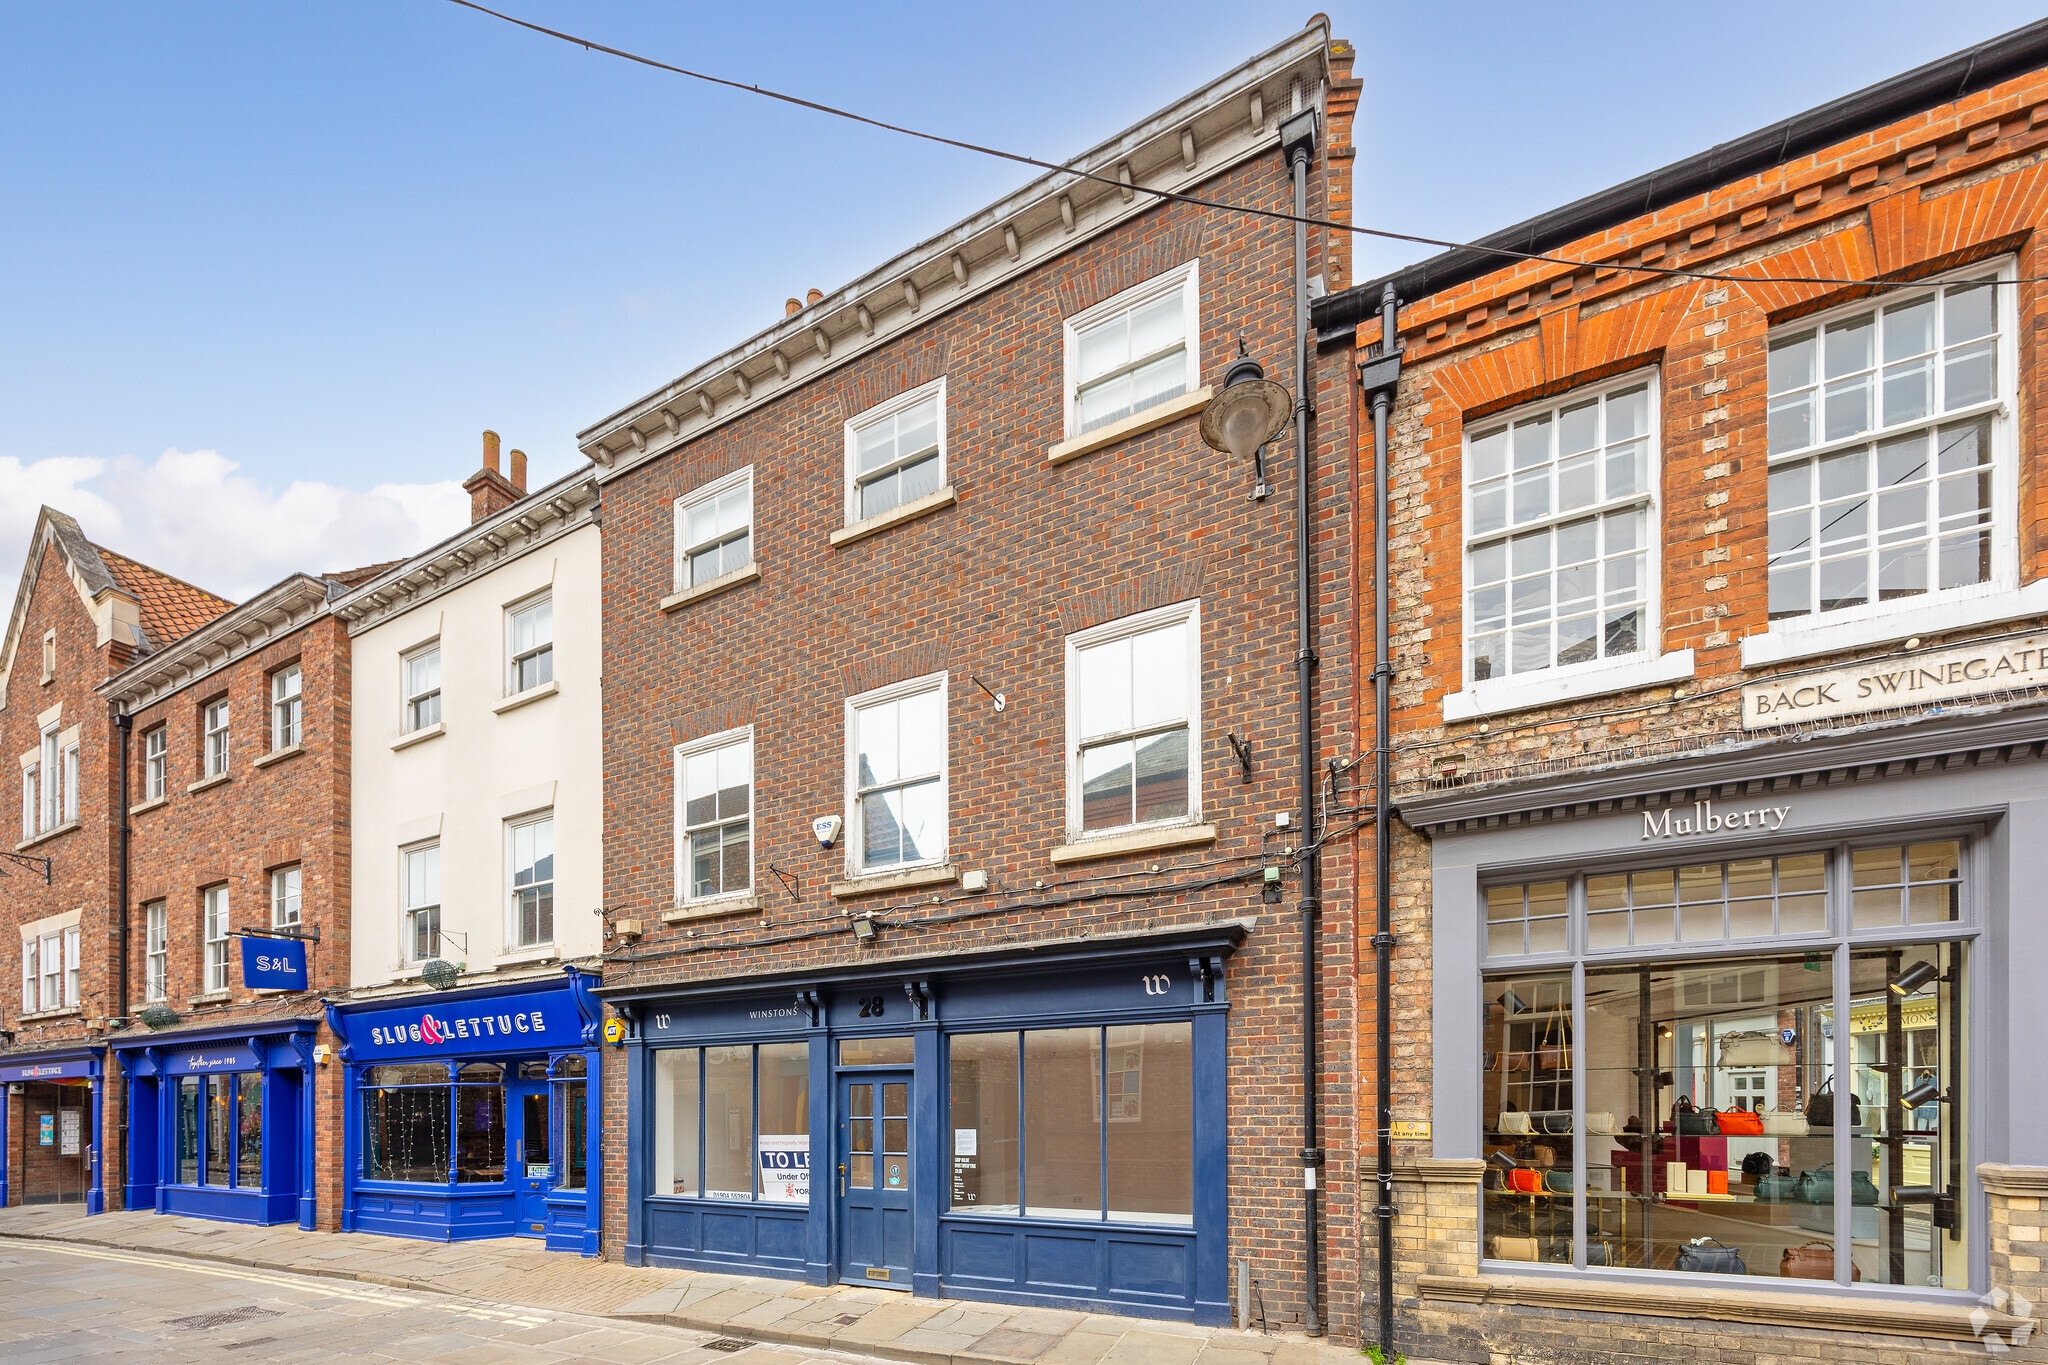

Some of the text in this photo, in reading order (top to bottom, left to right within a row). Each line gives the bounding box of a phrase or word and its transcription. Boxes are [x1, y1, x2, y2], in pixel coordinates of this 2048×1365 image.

[1756, 682, 1840, 715] BACK
[816, 821, 832, 831] ESS
[1641, 799, 1792, 840] Mulberry
[256, 955, 297, 973] S&L
[749, 1008, 798, 1019] WINSTONS
[858, 996, 885, 1018] 28
[765, 1152, 809, 1169] TO LE
[777, 1173, 798, 1181] Under
